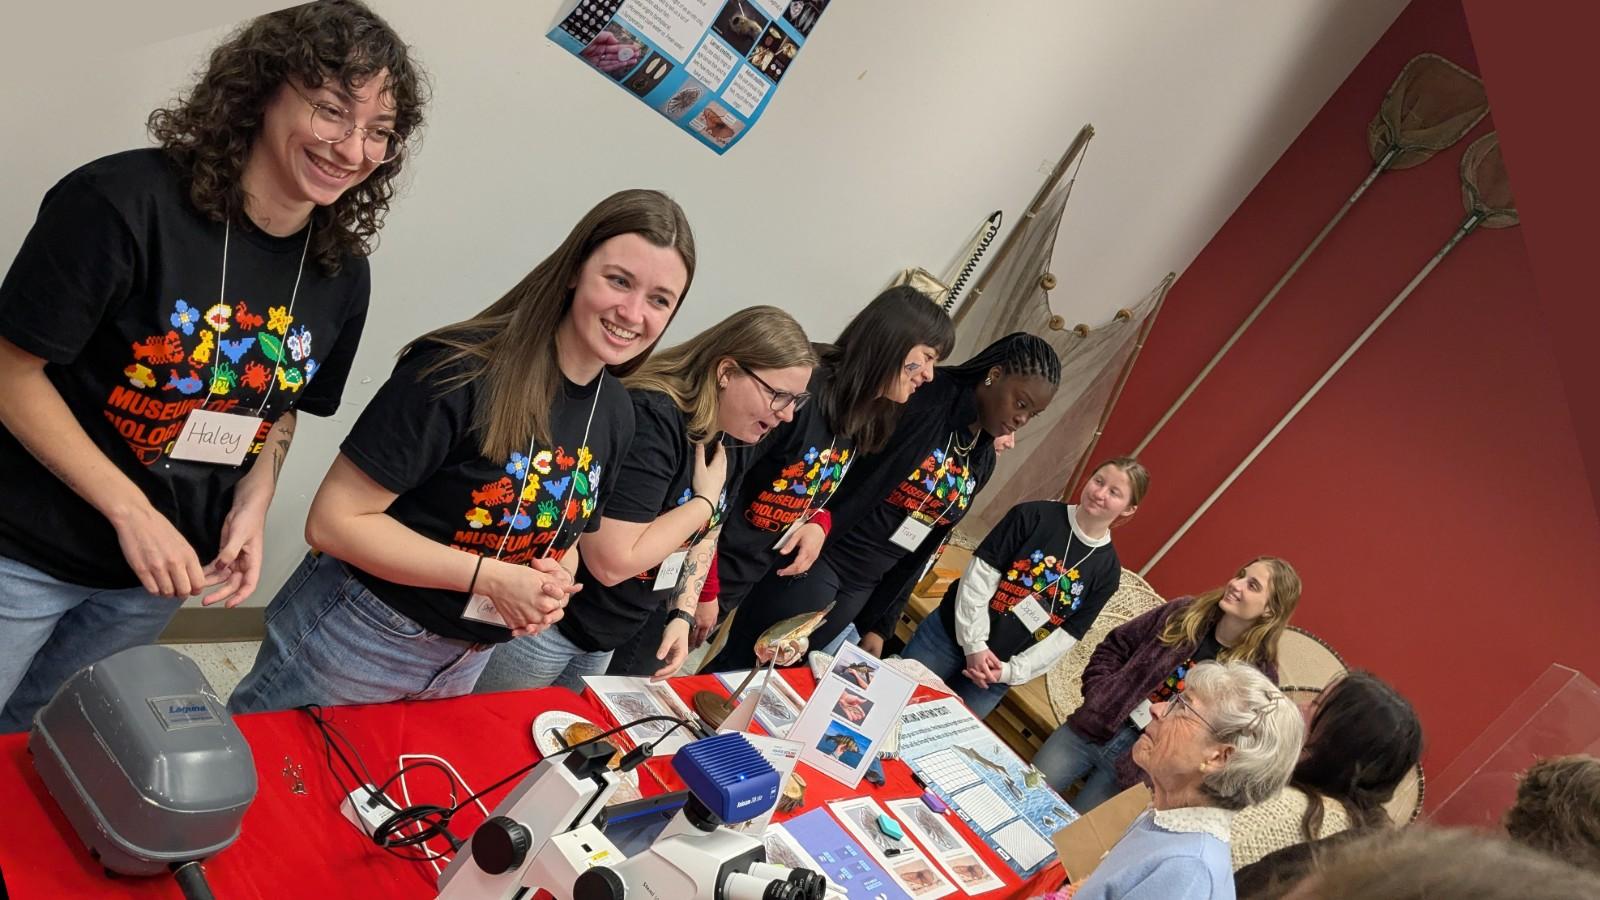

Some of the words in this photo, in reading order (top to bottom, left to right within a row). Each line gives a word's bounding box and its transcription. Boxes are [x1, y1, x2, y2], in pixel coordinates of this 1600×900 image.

[187, 422, 242, 454] Haley
[454, 531, 535, 552] MUSEUM
[169, 704, 207, 714] Laguna
